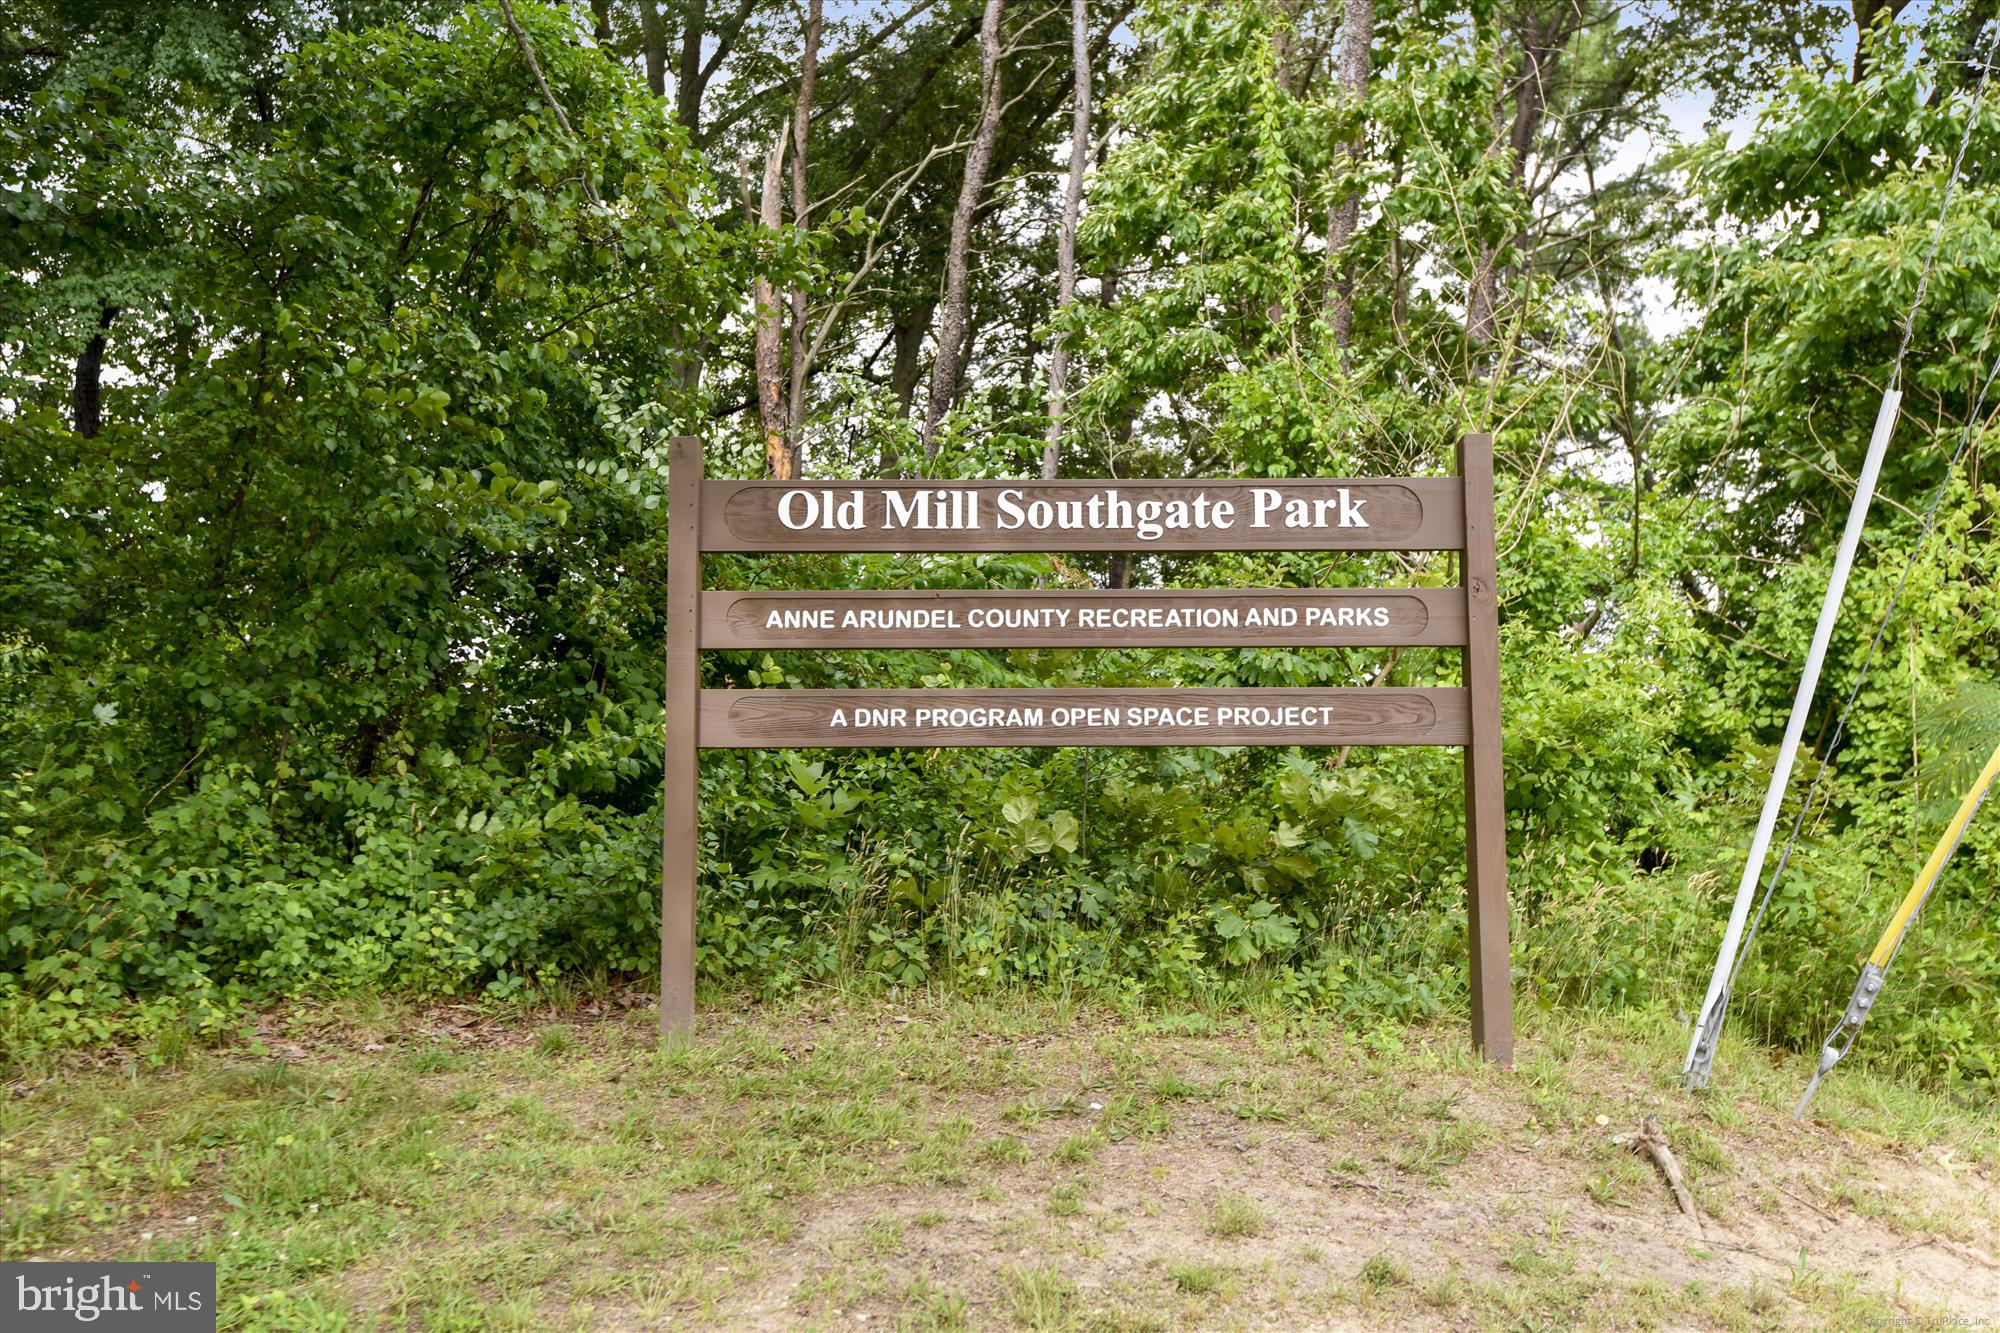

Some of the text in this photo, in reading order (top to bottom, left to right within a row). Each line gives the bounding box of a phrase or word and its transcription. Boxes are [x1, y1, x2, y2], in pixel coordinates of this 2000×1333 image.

[777, 488, 1370, 540] Old Mill Southgate Park
[765, 606, 1390, 629] ANNE ARUNDEL COUNTY RECREATION AND PARKS
[829, 706, 1334, 728] A DNR PROGRAM OPEN SPACE PROJECT
